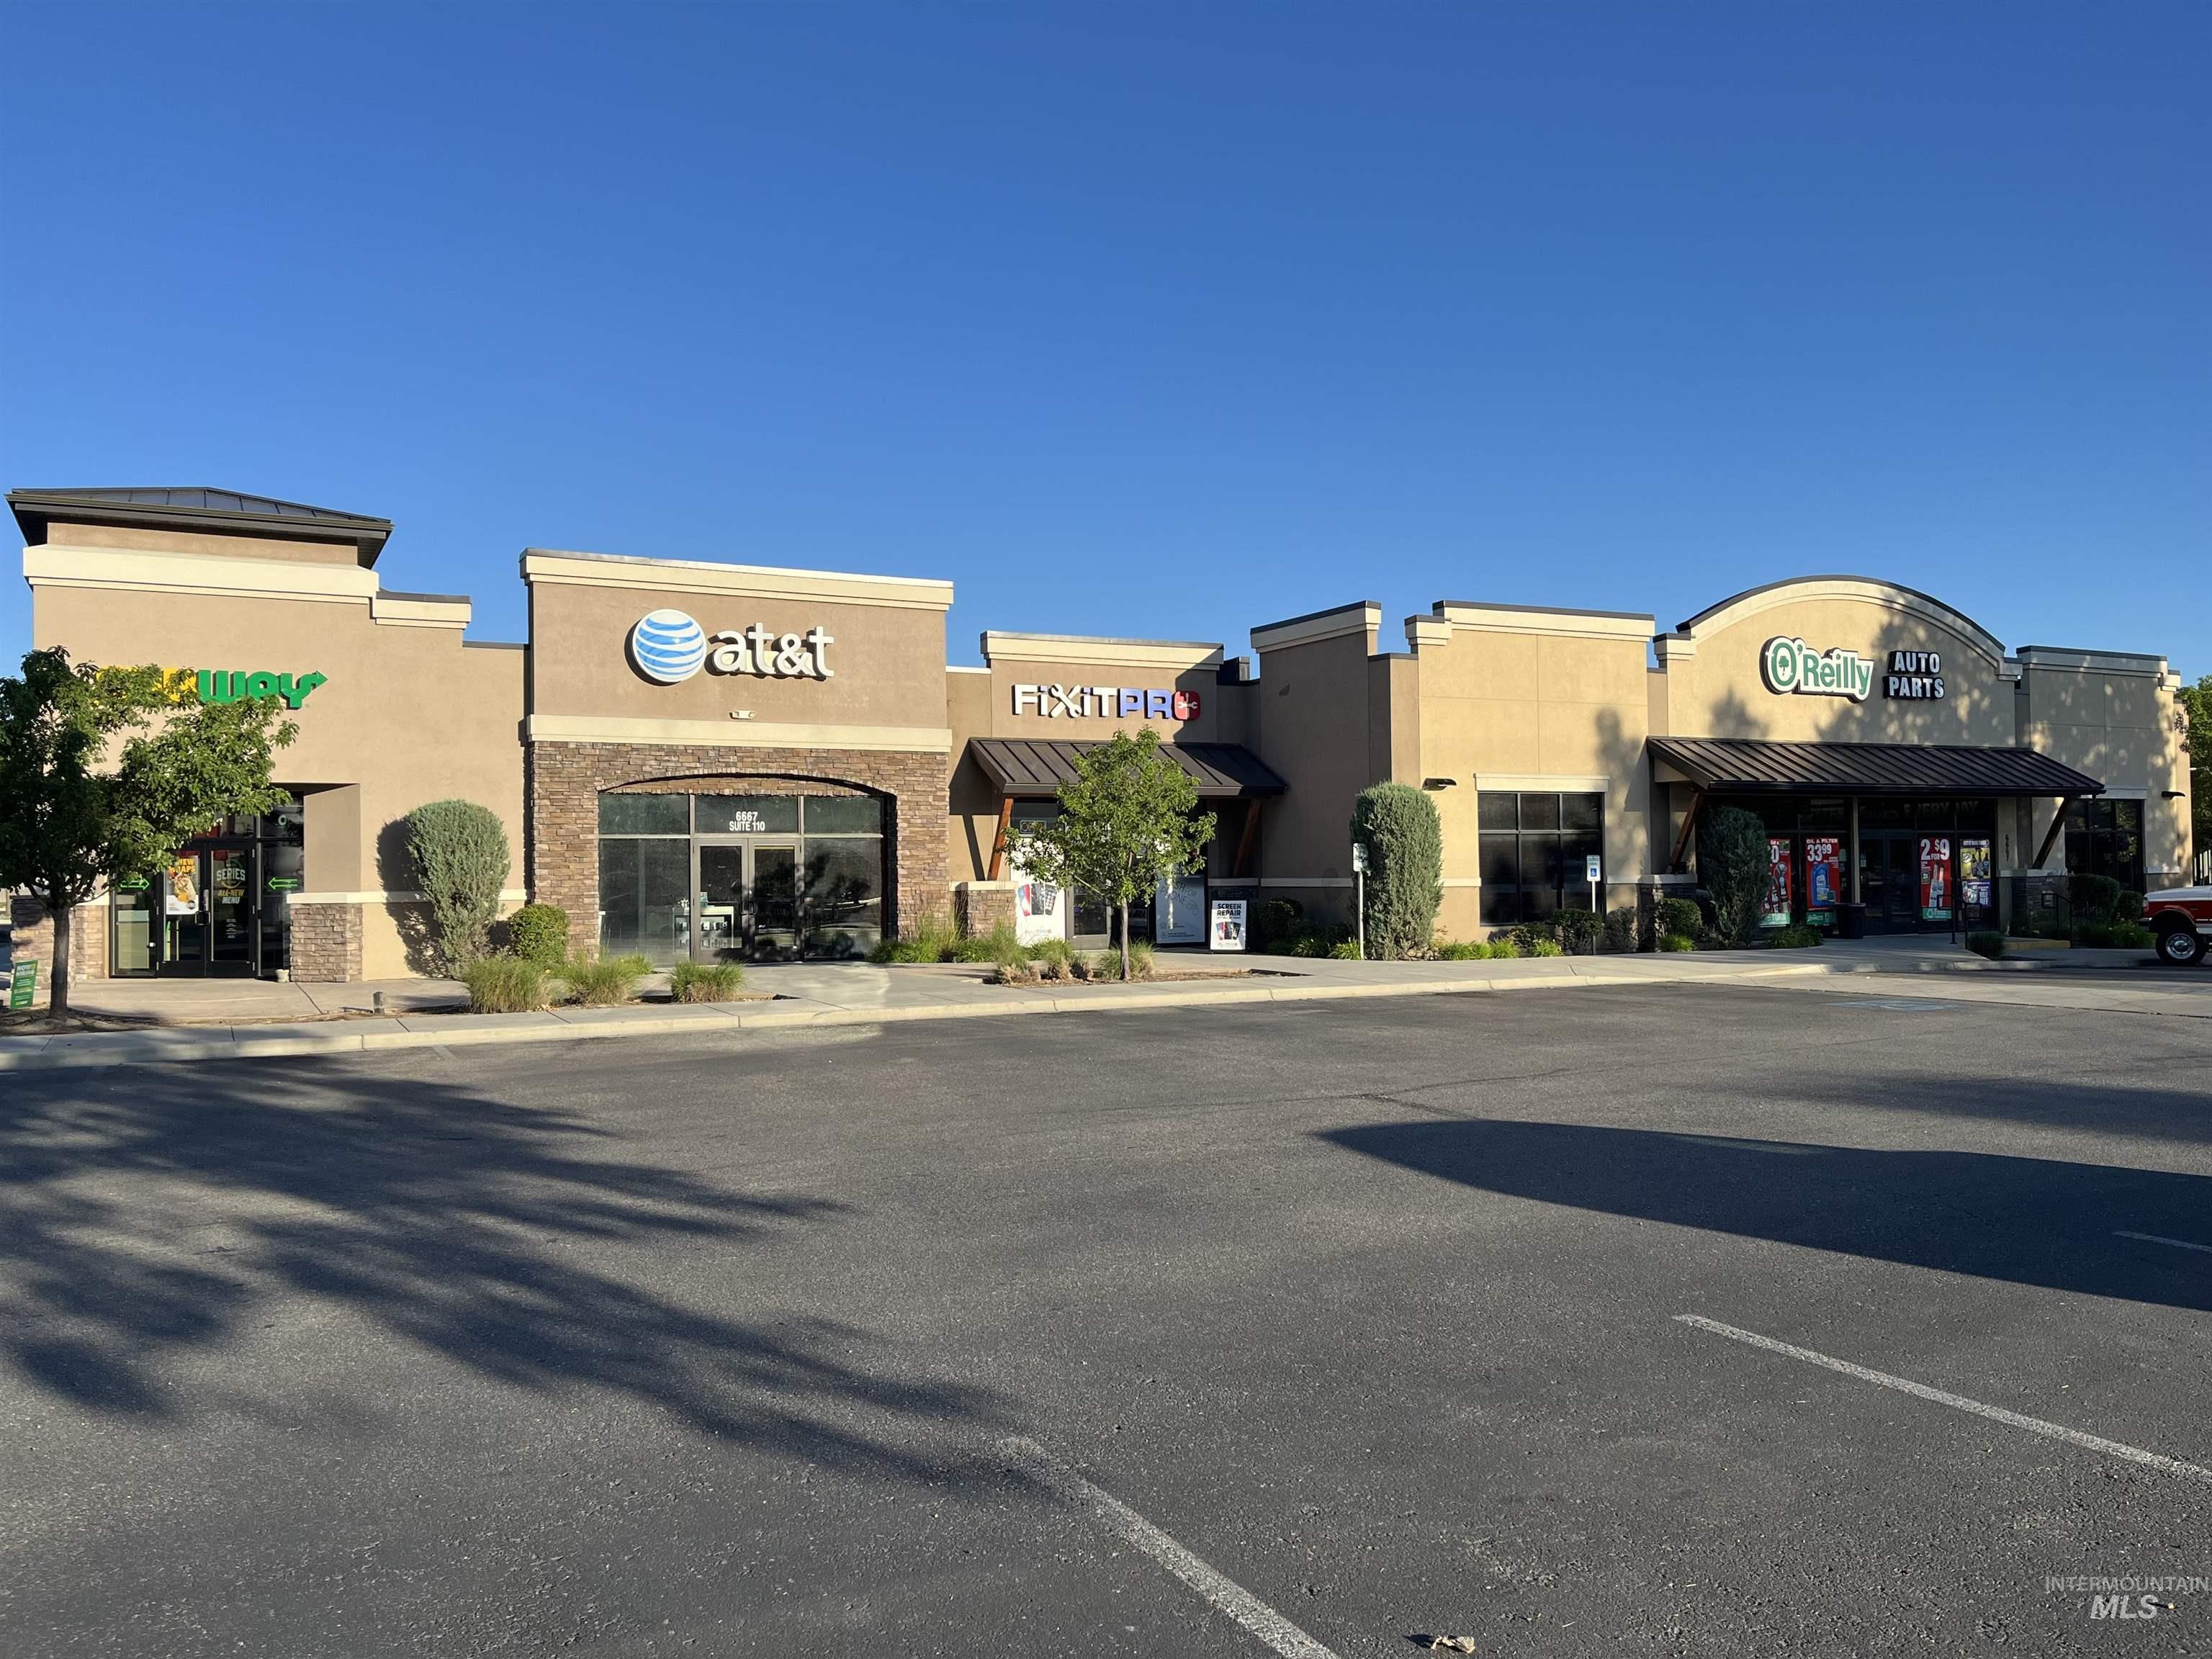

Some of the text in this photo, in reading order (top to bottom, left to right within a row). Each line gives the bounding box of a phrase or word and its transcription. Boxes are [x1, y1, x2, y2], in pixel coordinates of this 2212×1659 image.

[714, 623, 834, 677] at&t
[1771, 642, 1871, 696] O'Reilly
[1894, 652, 1941, 673] AUTO
[1889, 677, 1944, 698] PARTS
[729, 821, 765, 831] SUITE 110
[736, 811, 758, 821] 6667
[1920, 839, 1930, 860] 2
[216, 868, 246, 881] SERIES
[217, 889, 245, 897] ALL-NEW
